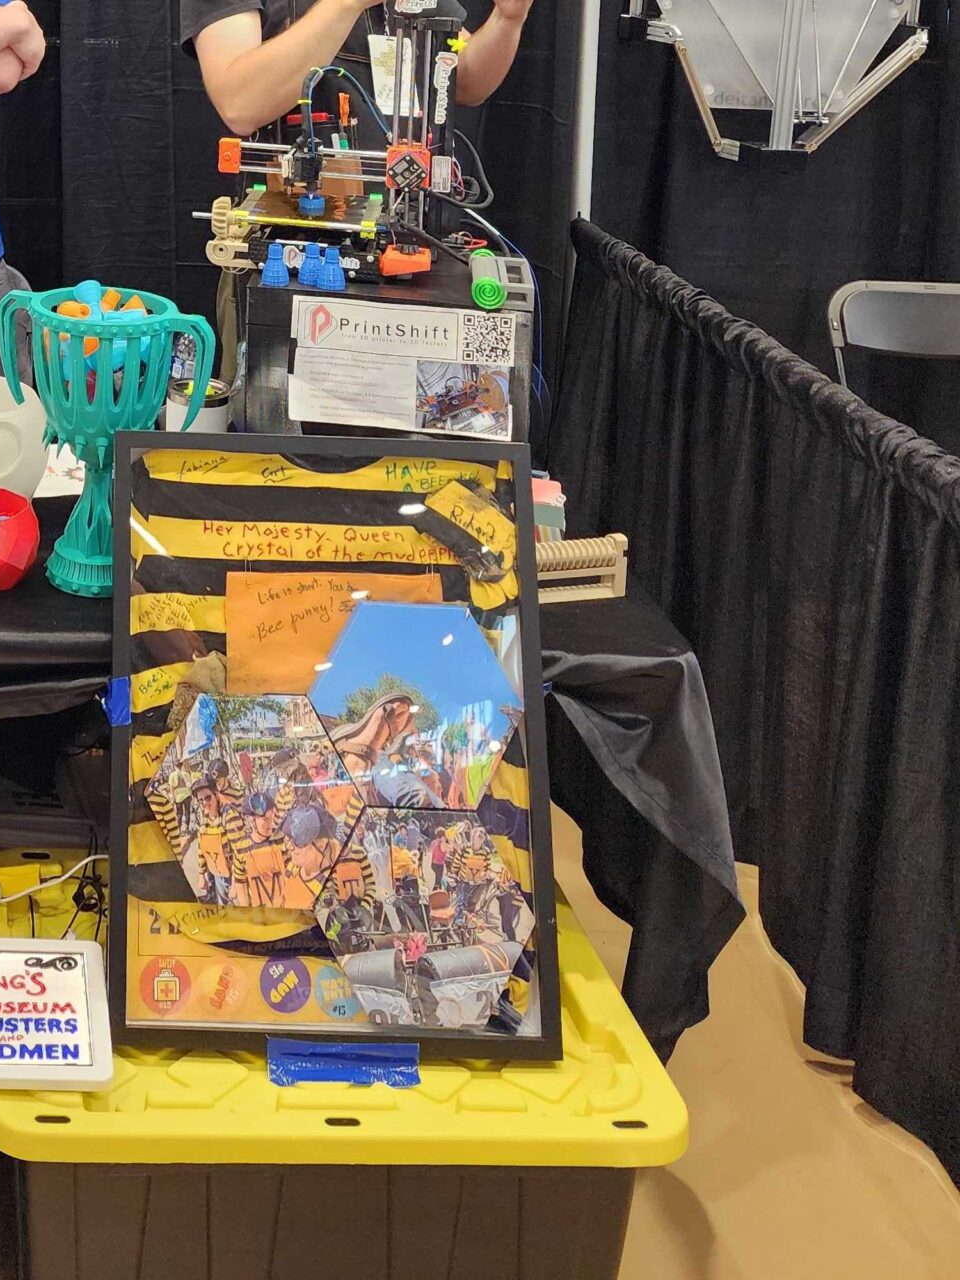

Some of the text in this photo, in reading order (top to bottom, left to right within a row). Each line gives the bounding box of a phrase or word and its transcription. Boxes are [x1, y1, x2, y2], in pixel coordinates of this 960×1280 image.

[339, 318, 449, 340] PrintShift
[203, 522, 232, 535] Her
[343, 528, 404, 542] Queen
[223, 542, 293, 559] Crystal
[306, 544, 322, 559] of
[332, 544, 365, 560] the
[256, 619, 283, 641] Bee
[270, 969, 300, 1004] MUD
